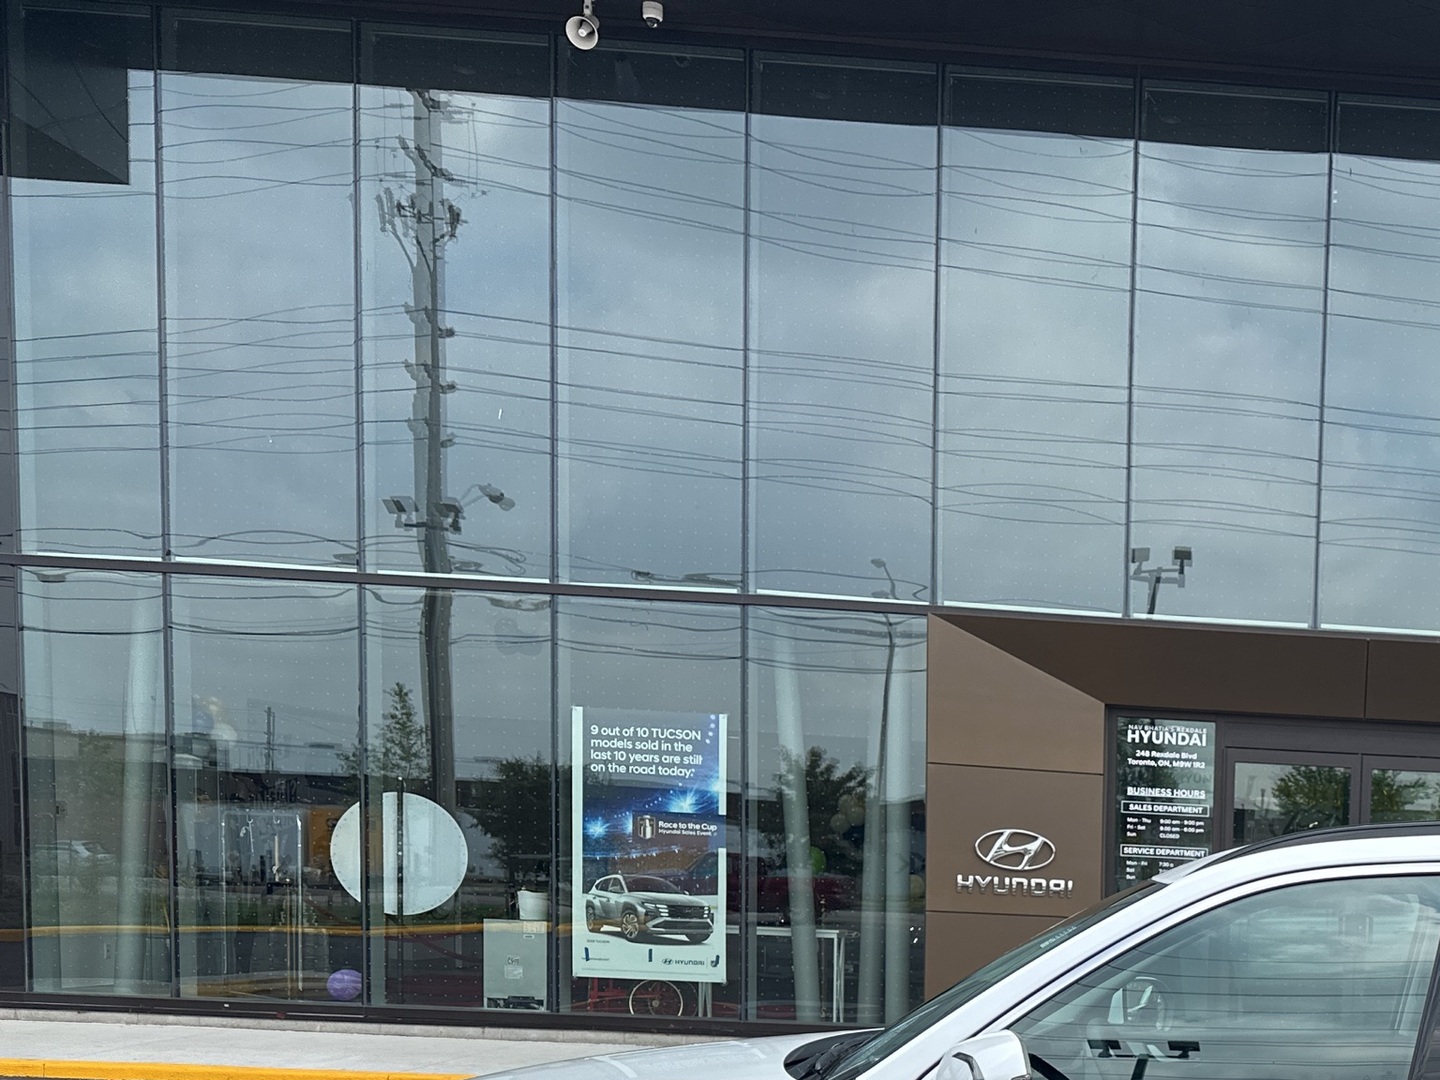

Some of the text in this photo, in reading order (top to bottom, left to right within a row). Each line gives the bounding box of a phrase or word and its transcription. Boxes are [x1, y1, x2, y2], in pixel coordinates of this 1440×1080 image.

[590, 725, 701, 740] 9 out of 10 TUCSON
[1127, 730, 1207, 746] HYUNDAI
[590, 738, 693, 752] models sold in the
[590, 750, 703, 765] last 10 years are still
[1127, 758, 1157, 767] Toronto,
[590, 764, 605, 772] on
[607, 763, 627, 773] the
[629, 765, 656, 774] road
[1127, 787, 1206, 798] BUSINESS HOURS
[1153, 805, 1203, 814] DEPARTMENT
[701, 823, 717, 831] Cup
[1156, 849, 1205, 857] DEPARTMENT
[957, 875, 1073, 898] HYUNDAI
